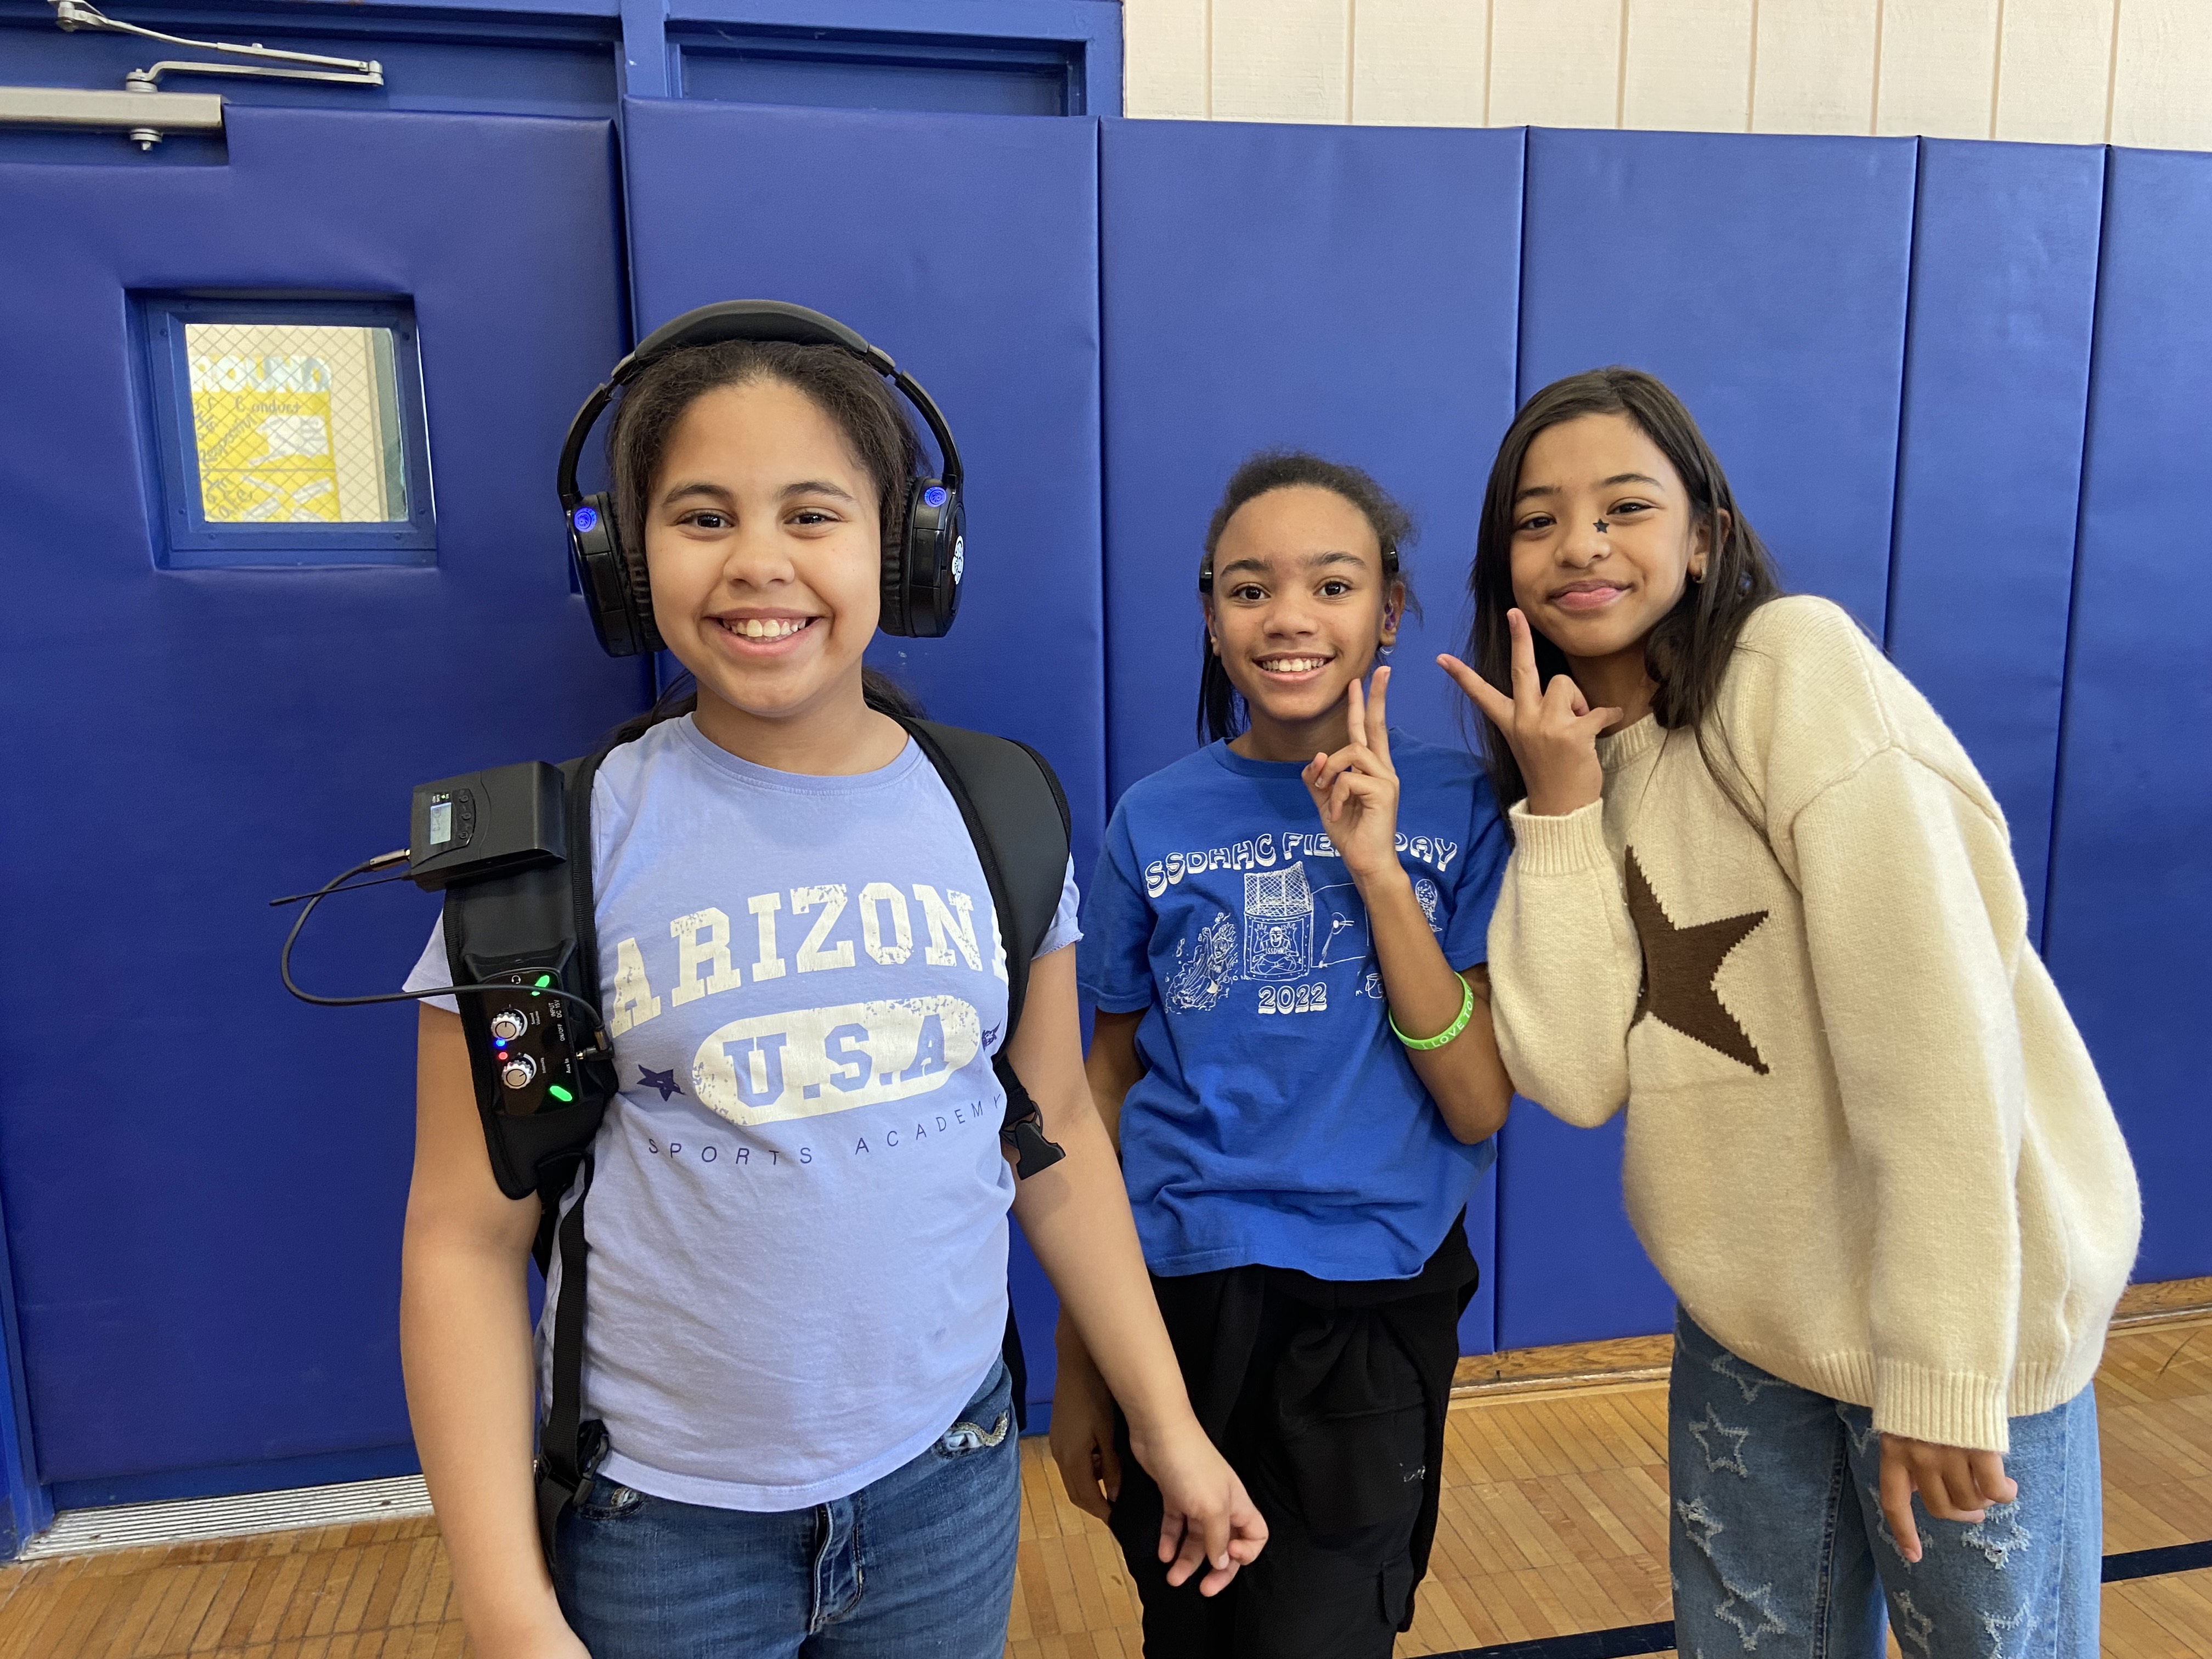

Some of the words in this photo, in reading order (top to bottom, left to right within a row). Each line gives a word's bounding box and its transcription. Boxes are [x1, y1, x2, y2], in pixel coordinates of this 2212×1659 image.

[1145, 833, 1277, 899] SSDHHC
[1282, 832, 1342, 861] FIE
[1257, 981, 1328, 1015] 2022
[1431, 1020, 1465, 1048] LOVE
[1463, 1000, 1473, 1019] TO
[649, 1137, 812, 1165] SPORTS
[855, 1093, 1002, 1156] ACADEMY
